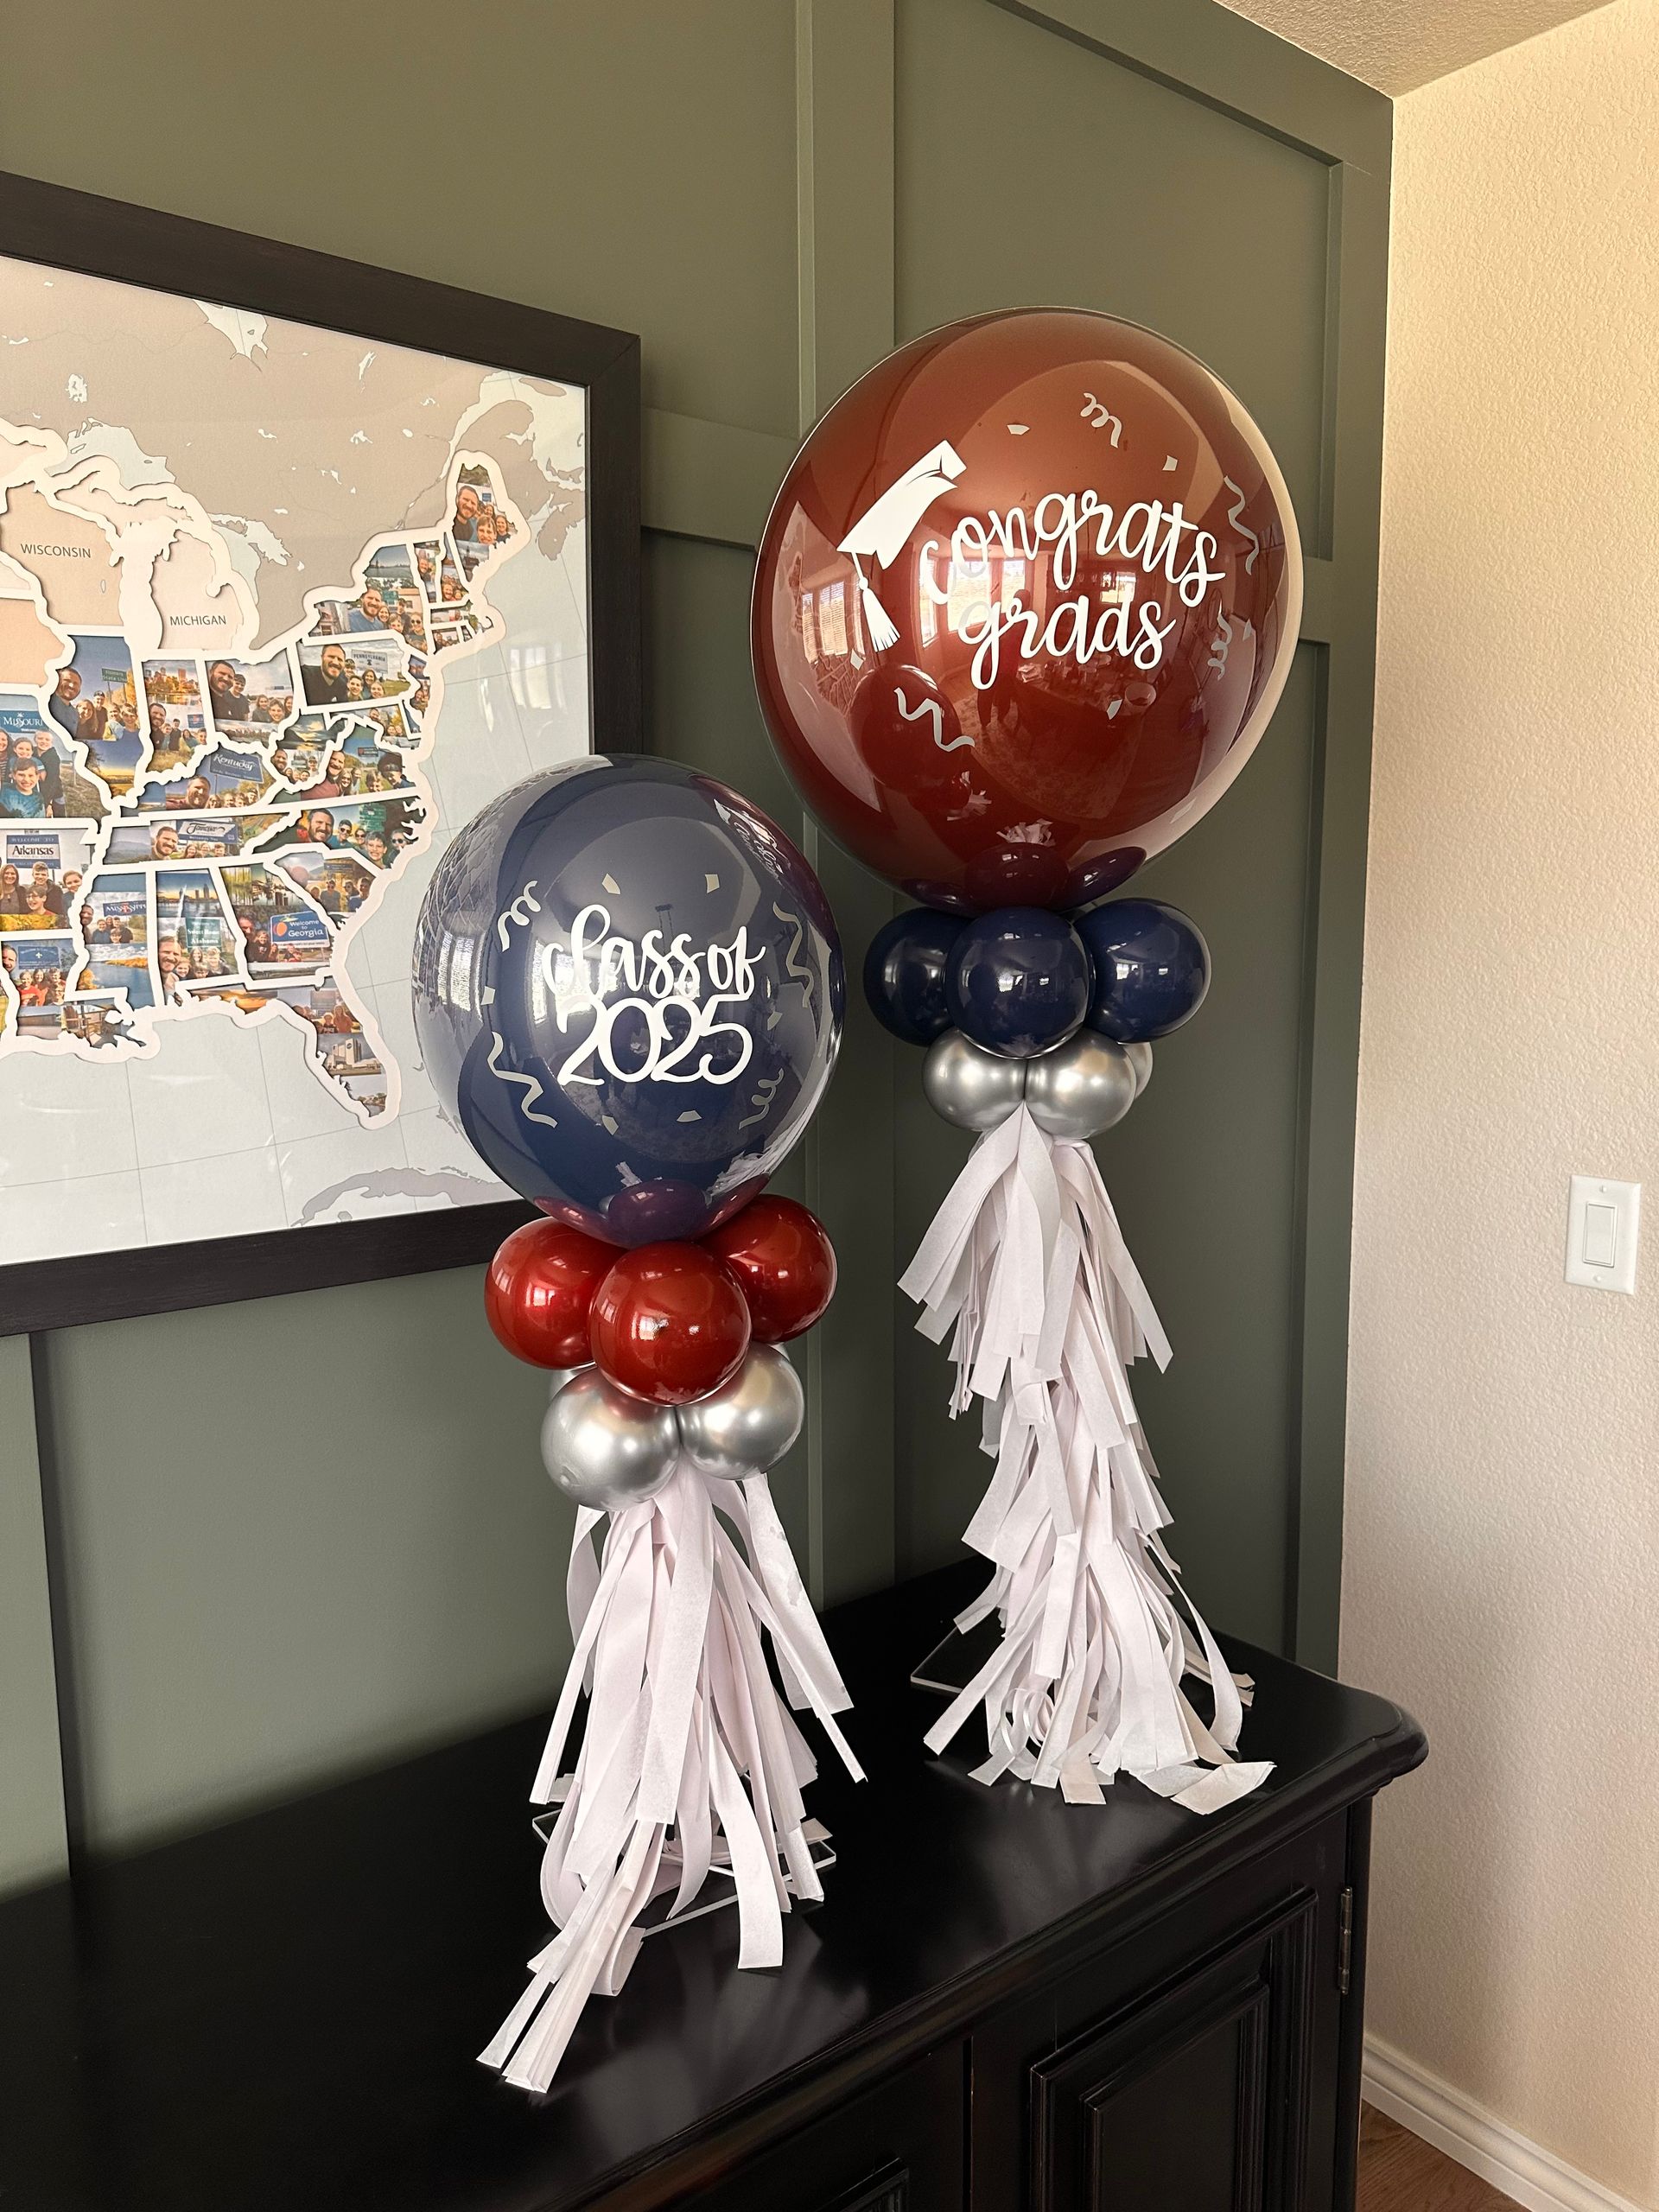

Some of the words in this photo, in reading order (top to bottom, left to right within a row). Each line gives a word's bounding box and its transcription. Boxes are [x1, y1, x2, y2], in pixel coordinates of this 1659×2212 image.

[20, 543, 92, 558] WISCONSIN
[919, 489, 1226, 607] congrats
[169, 614, 226, 626] MICHIGAN
[957, 594, 1176, 690] grads
[353, 653, 386, 662] PENNSYLVANIA
[213, 753, 257, 772] Kentucky
[12, 845, 54, 855] Arkansas
[288, 929, 324, 938] Georgia
[542, 904, 706, 1001] class
[707, 925, 766, 995] of
[557, 995, 753, 1085] 2025
